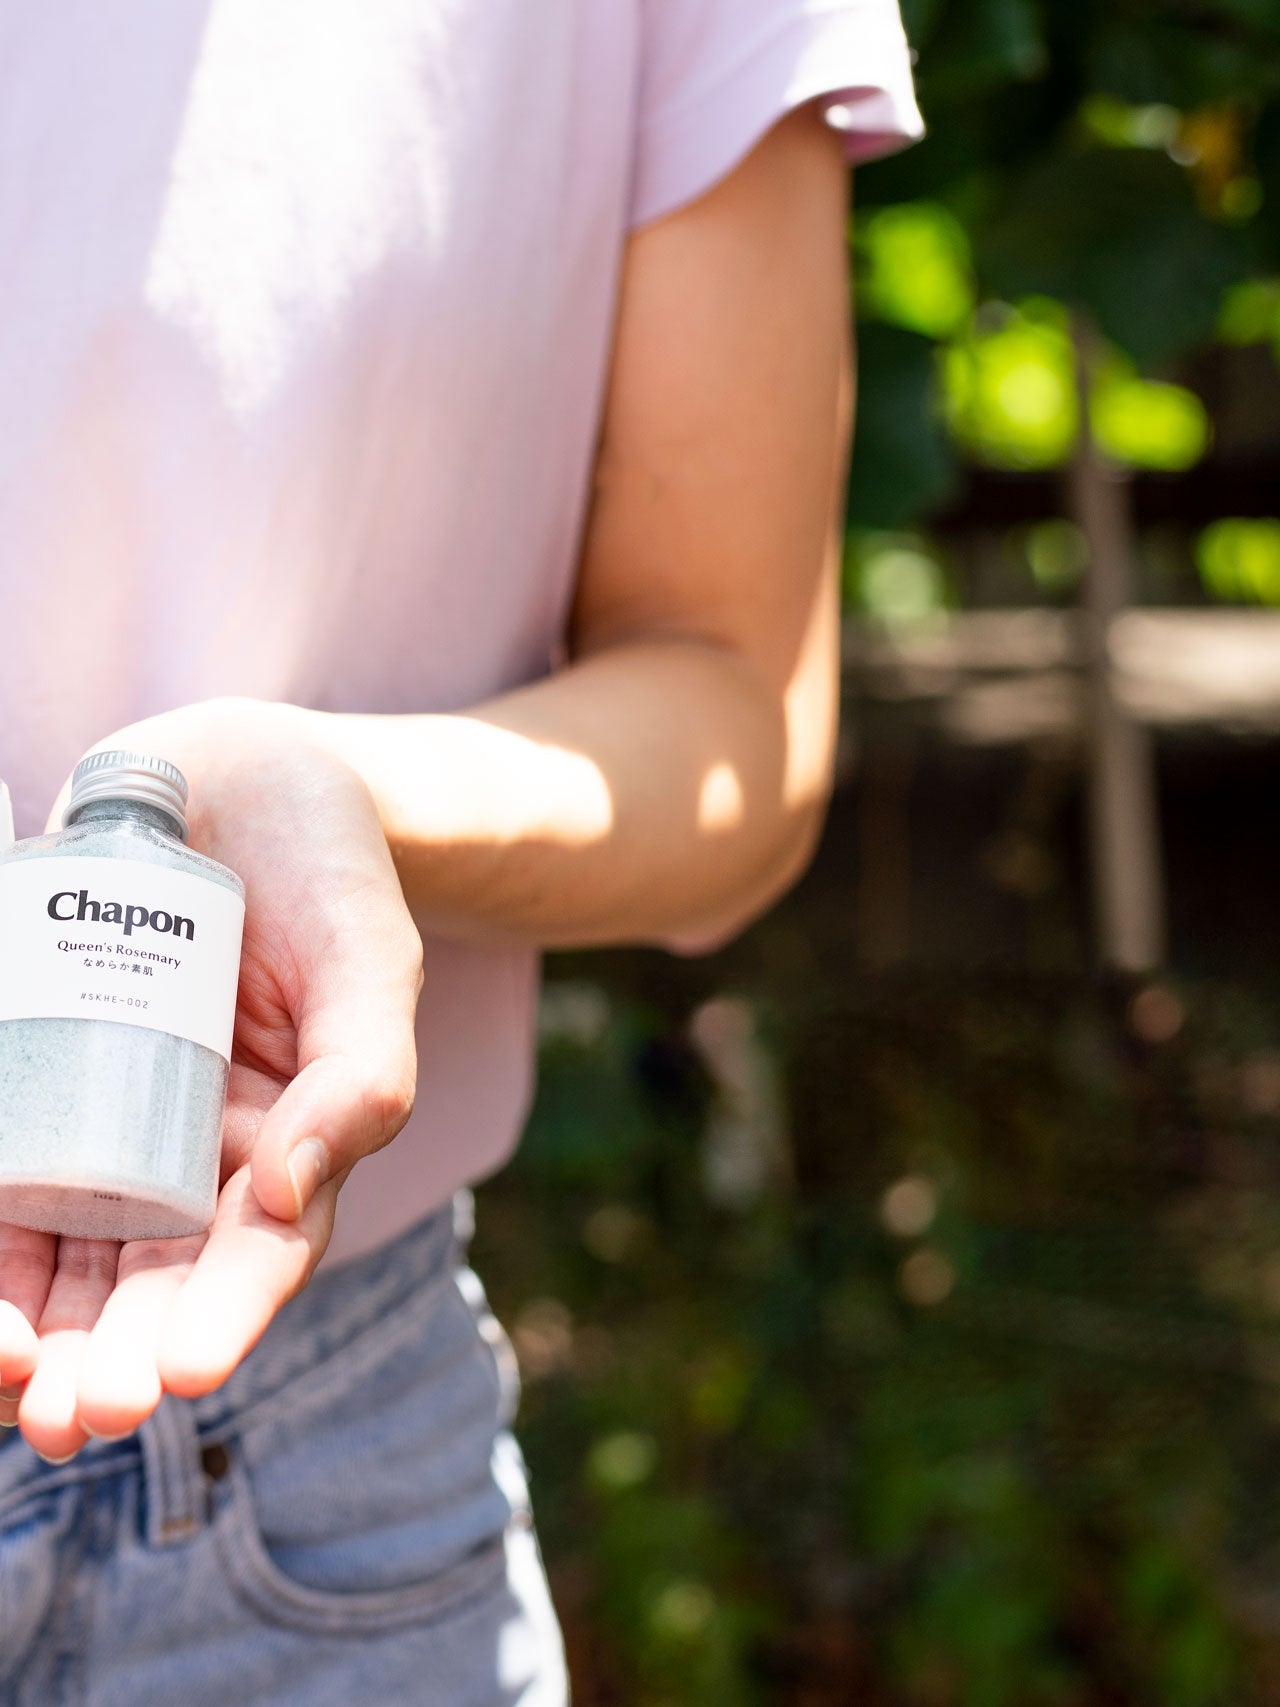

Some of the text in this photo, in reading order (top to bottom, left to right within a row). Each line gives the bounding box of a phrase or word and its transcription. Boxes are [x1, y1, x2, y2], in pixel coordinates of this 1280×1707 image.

[47, 889, 195, 941] Chapon
[57, 940, 181, 969] Queen's Rosemary
[83, 958, 153, 976] なめらか素肌
[80, 992, 149, 1009] #SKHE-002
